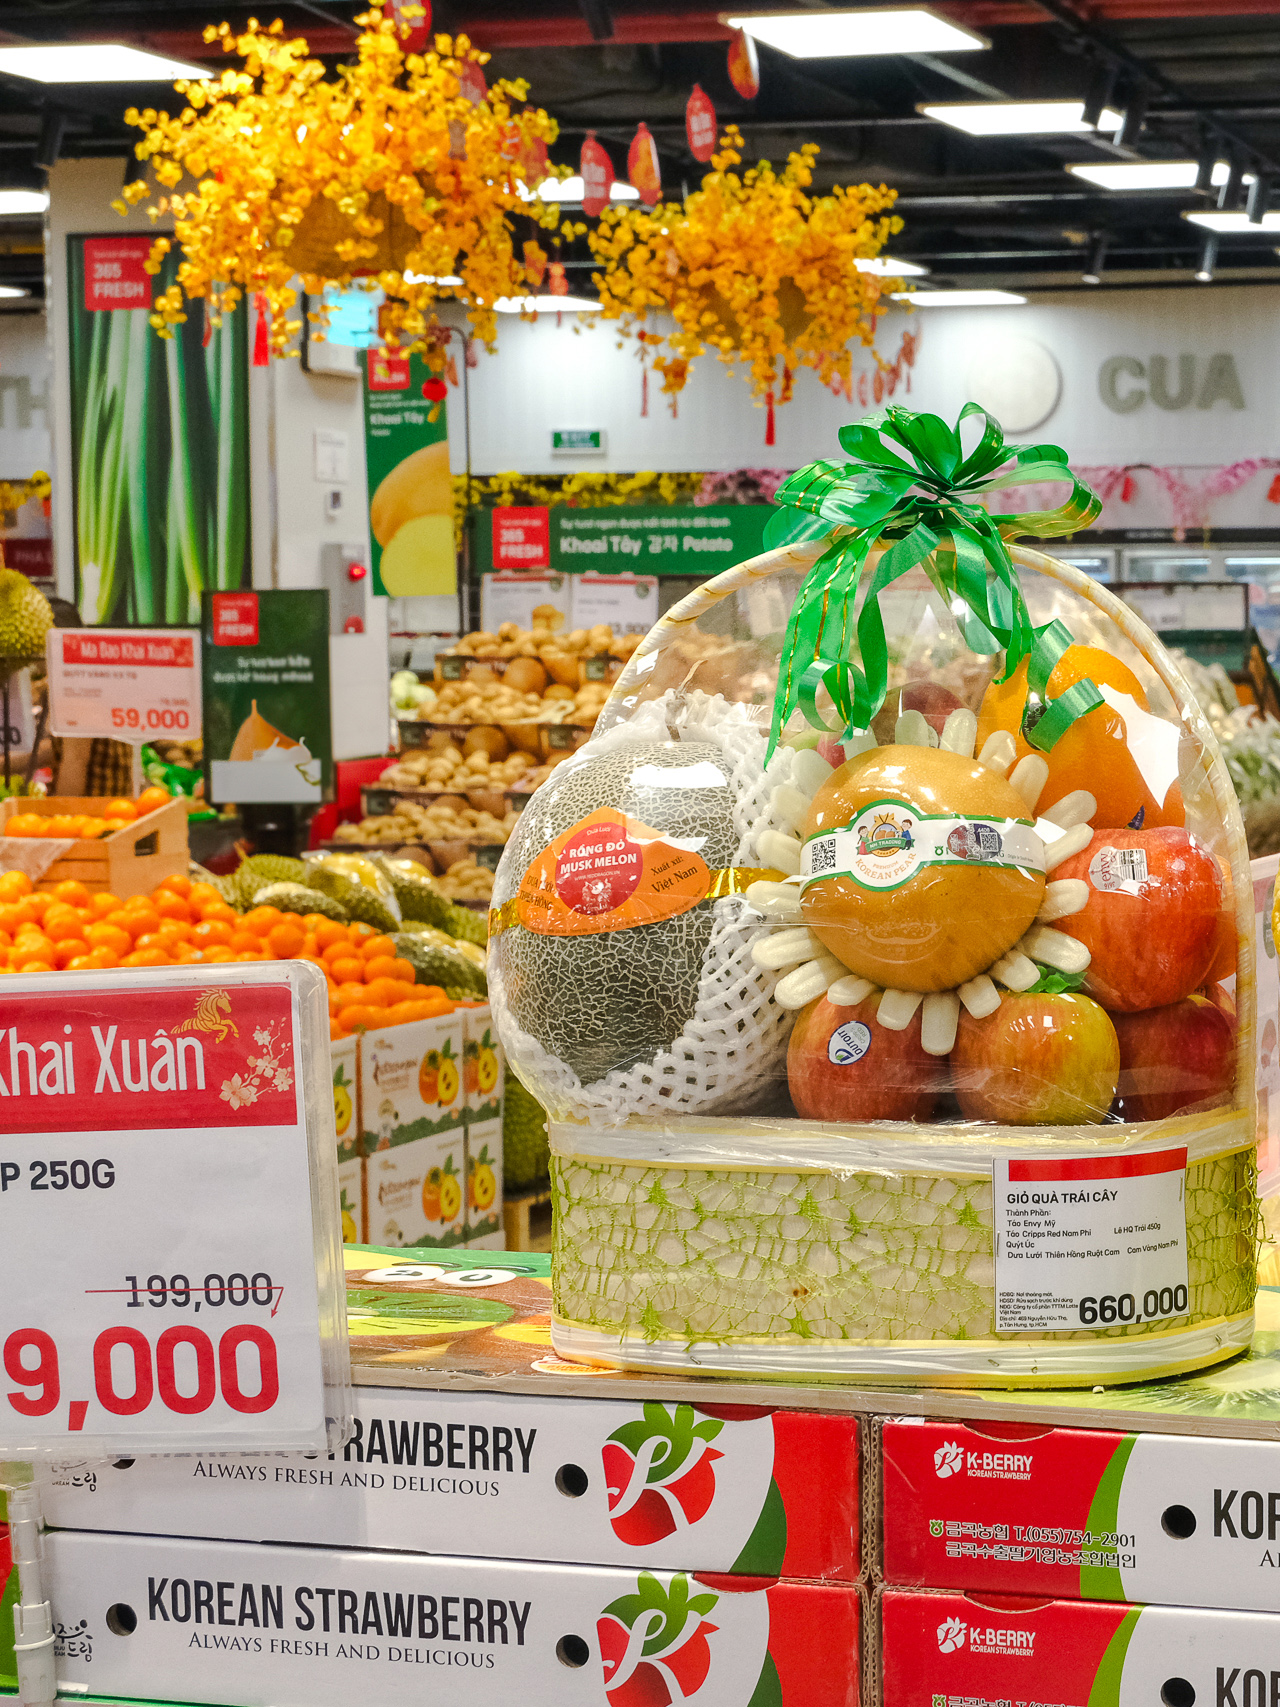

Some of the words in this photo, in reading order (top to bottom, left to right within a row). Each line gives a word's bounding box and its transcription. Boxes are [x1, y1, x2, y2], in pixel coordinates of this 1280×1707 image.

[93, 281, 146, 300] FRESH
[1099, 353, 1245, 413] CUA
[560, 537, 607, 554] Khoai
[611, 536, 641, 556] Tây
[111, 707, 189, 731] 59,000
[606, 839, 625, 852] ĐỎ
[561, 860, 592, 874] MUSK
[595, 853, 637, 869] MELON
[651, 862, 670, 876] Xuất
[672, 856, 684, 867] xứ:
[855, 858, 892, 880] KOREAN
[894, 851, 916, 877] PEAR
[873, 861, 898, 869] PREMIUM
[1101, 853, 1111, 881] envy
[652, 879, 674, 894] Việt
[676, 867, 698, 884] Nam
[838, 1030, 863, 1055] DUTOIT
[91, 1028, 206, 1094] Xuân
[29, 1158, 116, 1190] 250G
[1007, 1191, 1029, 1204] GIỎ
[1032, 1191, 1059, 1204] QUÀ
[1061, 1190, 1090, 1203] TRÁI
[1093, 1189, 1118, 1202] CÂY
[1030, 1208, 1051, 1216] Phần:
[1022, 1230, 1045, 1238] Cripps
[1024, 1220, 1041, 1228] Envy
[1044, 1220, 1056, 1228] Mỹ
[1147, 1223, 1161, 1231] 450g
[1006, 1240, 1023, 1249] Quýt
[1025, 1240, 1035, 1248] Úc
[1127, 1246, 1142, 1254] Cam
[1142, 1244, 1157, 1253] Vàng
[1158, 1242, 1169, 1250] Nam
[1170, 1239, 1178, 1247] Phi
[1067, 1250, 1085, 1260] Hồng
[1087, 1250, 1103, 1258] Ruột
[126, 1273, 273, 1312] 199,000
[1079, 1284, 1188, 1325] 660,000
[967, 1452, 1033, 1472] K-BERRY
[193, 1460, 268, 1482] ALWAYS
[274, 1467, 334, 1486] FRESH
[340, 1472, 385, 1489] AND
[392, 1474, 500, 1497] DELICIOUS
[967, 1469, 992, 1479] KOREAN
[993, 1470, 1032, 1481] STRAWBERRY
[147, 1576, 284, 1629] KOREAN
[294, 1586, 532, 1646] STRAWBERRY
[970, 1627, 1036, 1648] K-BERRY
[188, 1631, 262, 1652] ALWAYS
[270, 1638, 329, 1657] FRESH
[336, 1644, 380, 1660] AND
[388, 1647, 495, 1669] DELICIOUS
[970, 1644, 995, 1654] KOREAN
[996, 1646, 1035, 1657] STRAWBERRY
